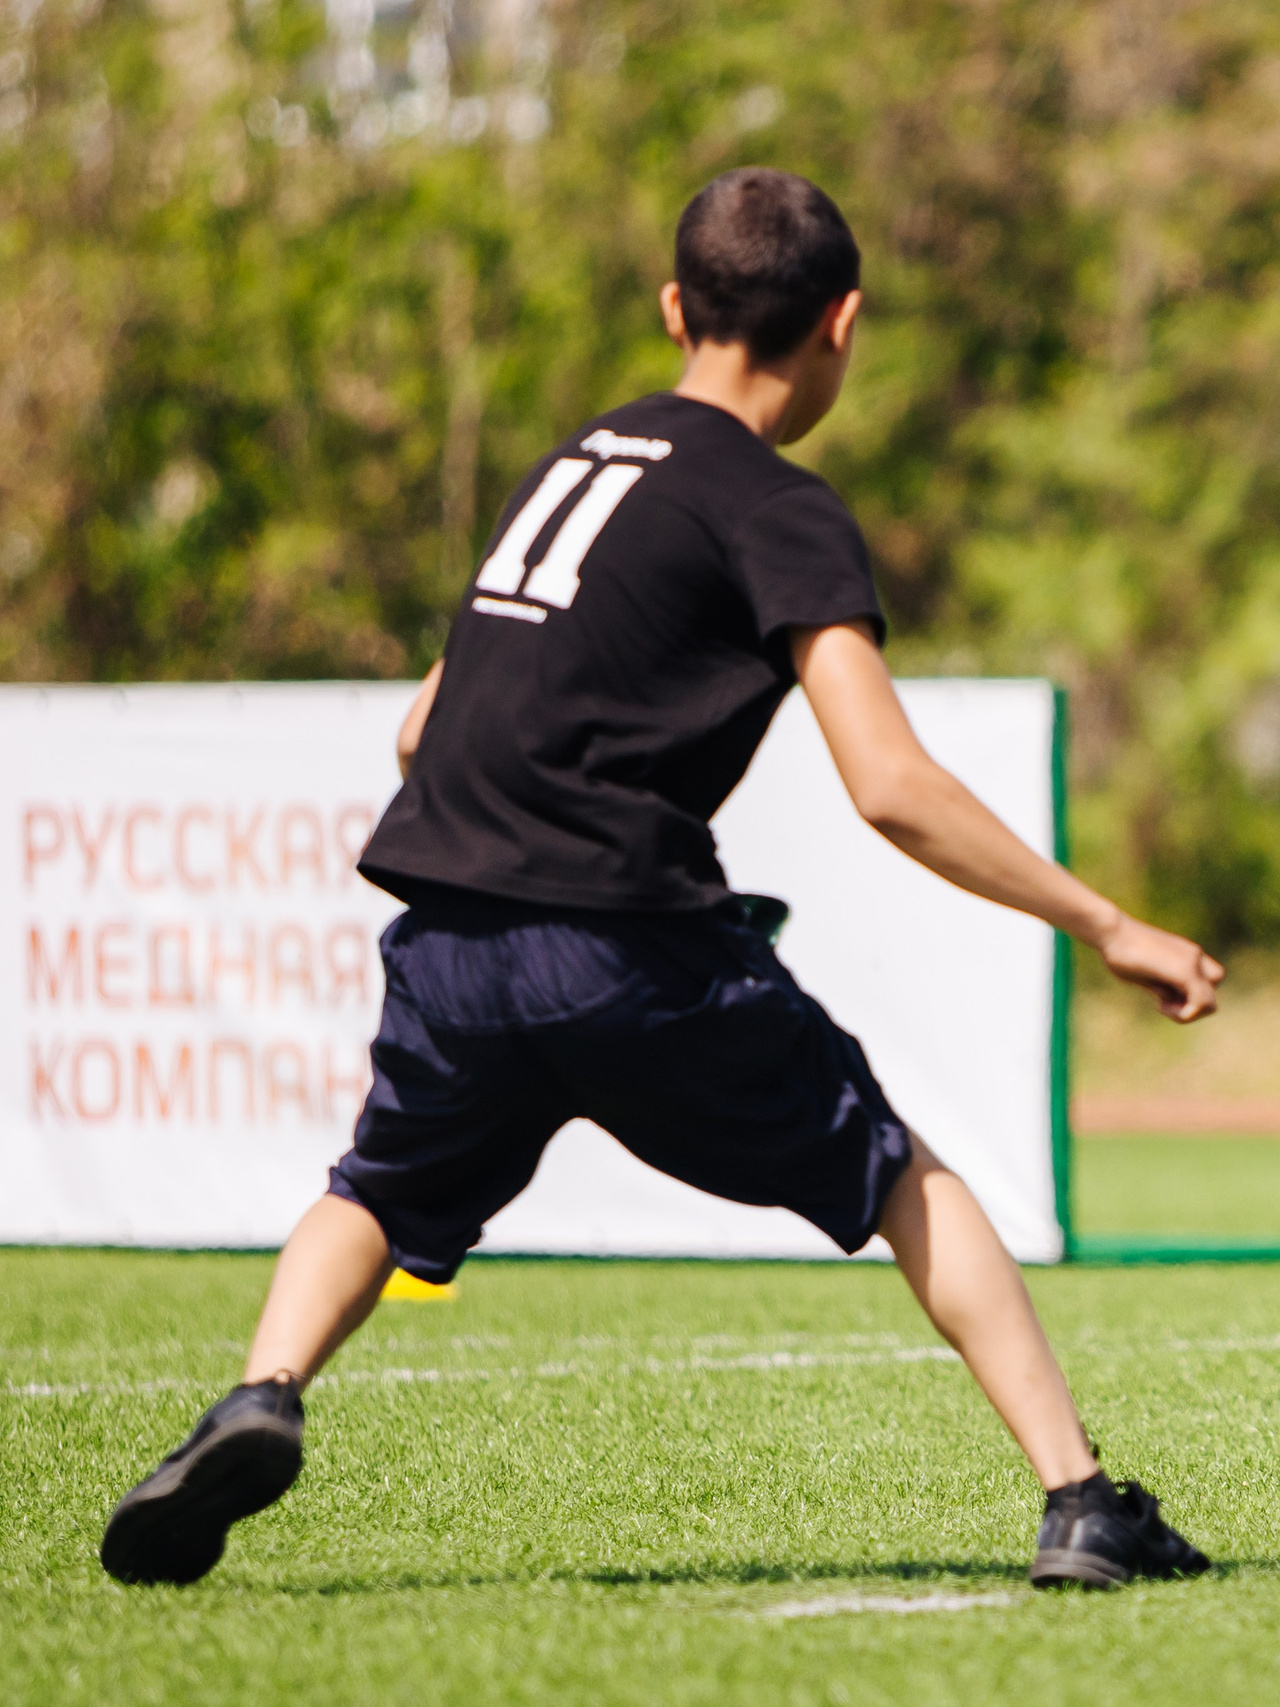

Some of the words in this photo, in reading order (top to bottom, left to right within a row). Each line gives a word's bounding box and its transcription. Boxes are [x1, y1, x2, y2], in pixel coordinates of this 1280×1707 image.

[475, 457, 645, 610] 11
[22, 802, 375, 891] РУССКАЯ
[27, 919, 371, 1009] МЕДНАЯ
